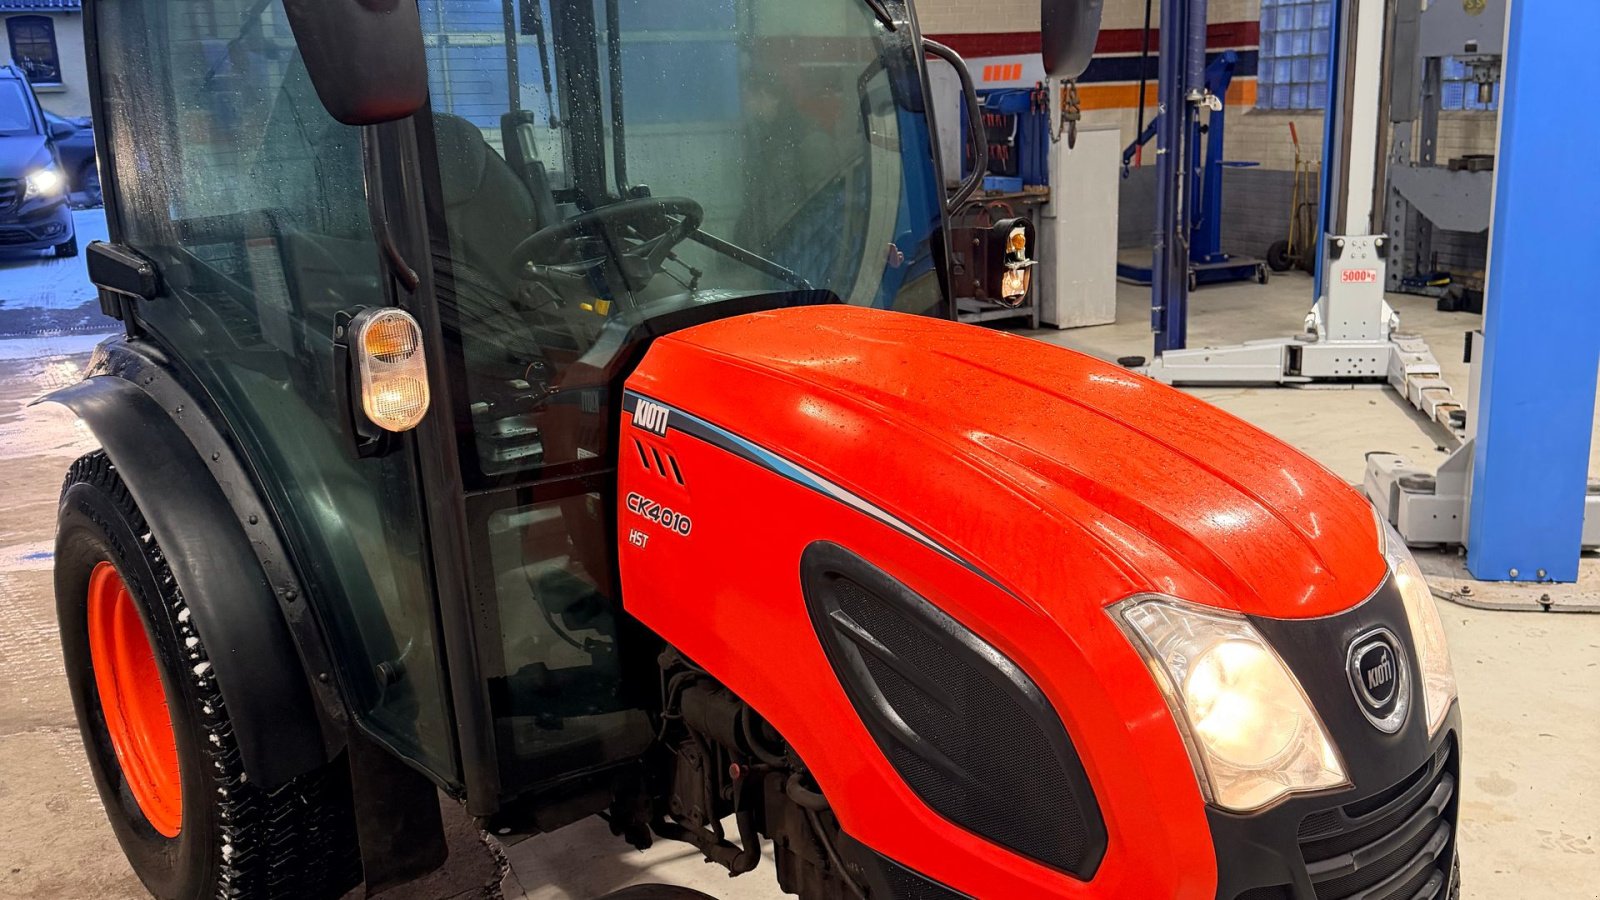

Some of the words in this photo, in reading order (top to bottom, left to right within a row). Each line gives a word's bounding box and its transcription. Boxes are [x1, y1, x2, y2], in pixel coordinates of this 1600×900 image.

[633, 399, 669, 435] KIOTI
[626, 492, 692, 536] CK4010
[628, 528, 649, 549] HST
[1367, 660, 1392, 690] KIOTI
